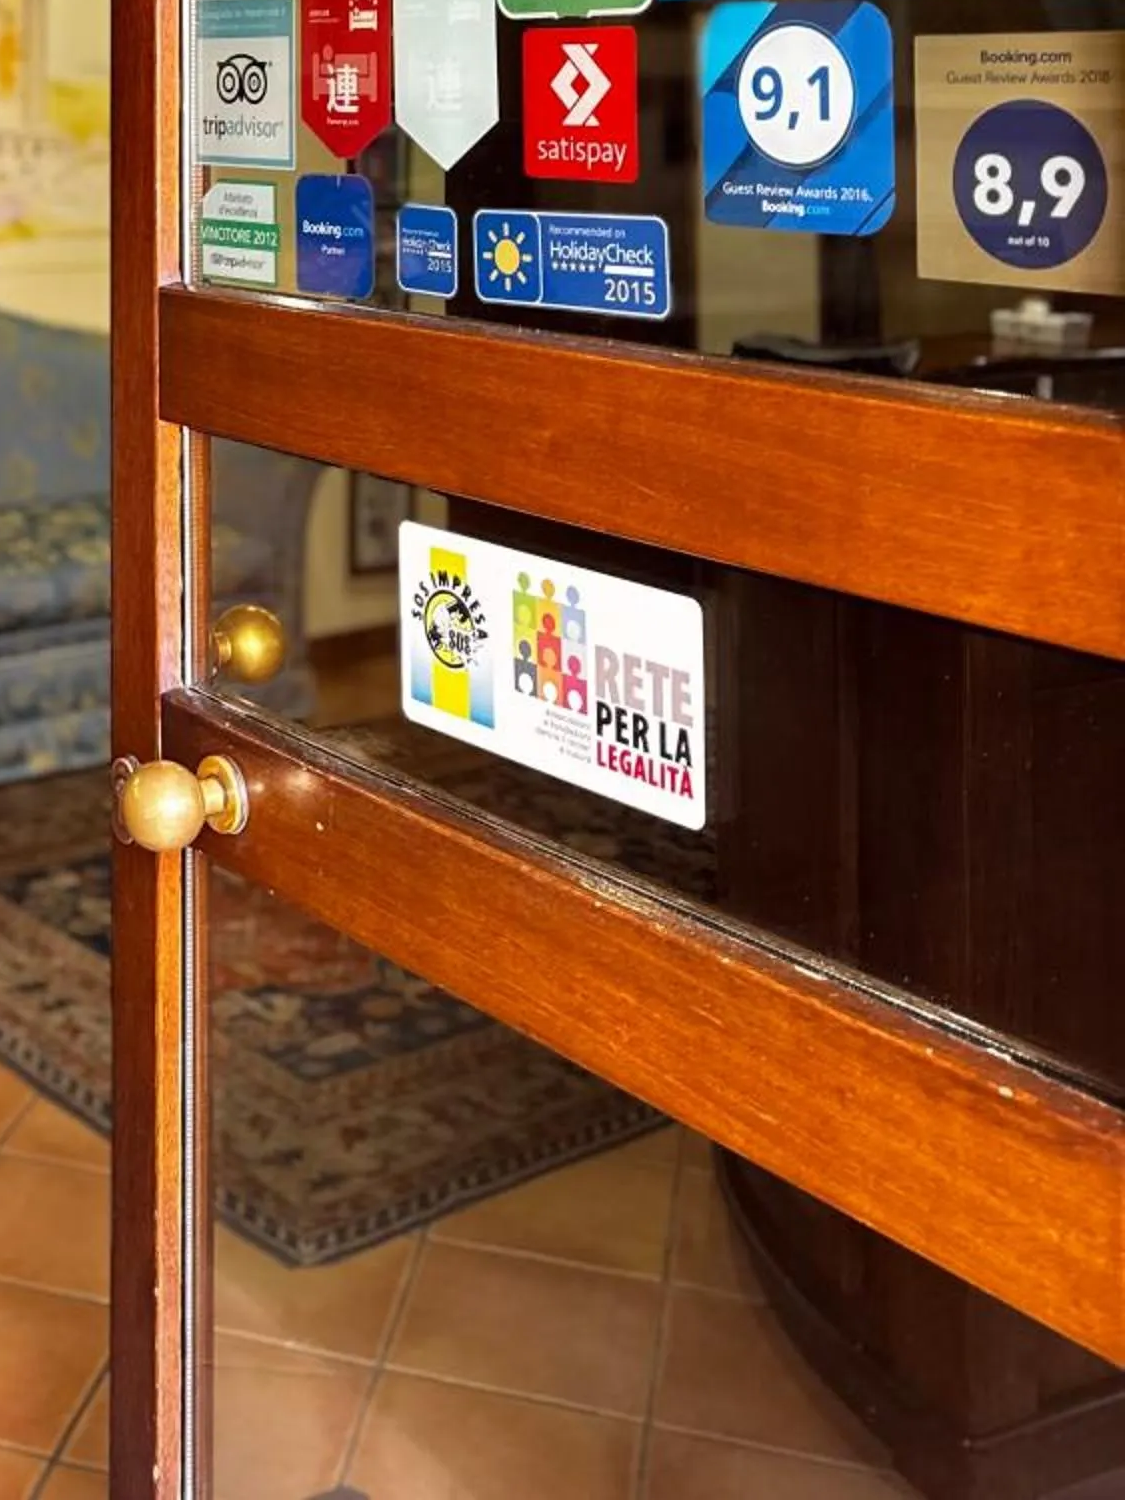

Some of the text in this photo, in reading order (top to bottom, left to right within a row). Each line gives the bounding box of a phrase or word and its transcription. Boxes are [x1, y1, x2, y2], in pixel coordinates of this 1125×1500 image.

[980, 49, 1072, 66] Booking.com
[985, 69, 1026, 85] Review
[1029, 70, 1076, 85] Awards
[751, 65, 831, 131] 9,1
[203, 113, 277, 142] tripadvisor
[538, 136, 627, 172] satispay
[722, 181, 754, 195] Guest
[756, 183, 793, 198] Review
[795, 185, 838, 200] Awards
[973, 152, 1086, 227] 8,9
[762, 200, 830, 217] Booking.com
[200, 225, 278, 247] VINCITORE 2012
[302, 219, 364, 239] Booking.com
[1037, 236, 1050, 248] 10
[427, 258, 452, 274] 2015
[550, 240, 654, 269] HolidayCheck
[604, 278, 656, 306] 2015
[411, 569, 489, 639] SOS IMPRESA
[594, 644, 693, 728] RETE
[596, 700, 650, 753] PER
[658, 720, 694, 767] LA
[596, 740, 695, 800] LEGALITÀ
